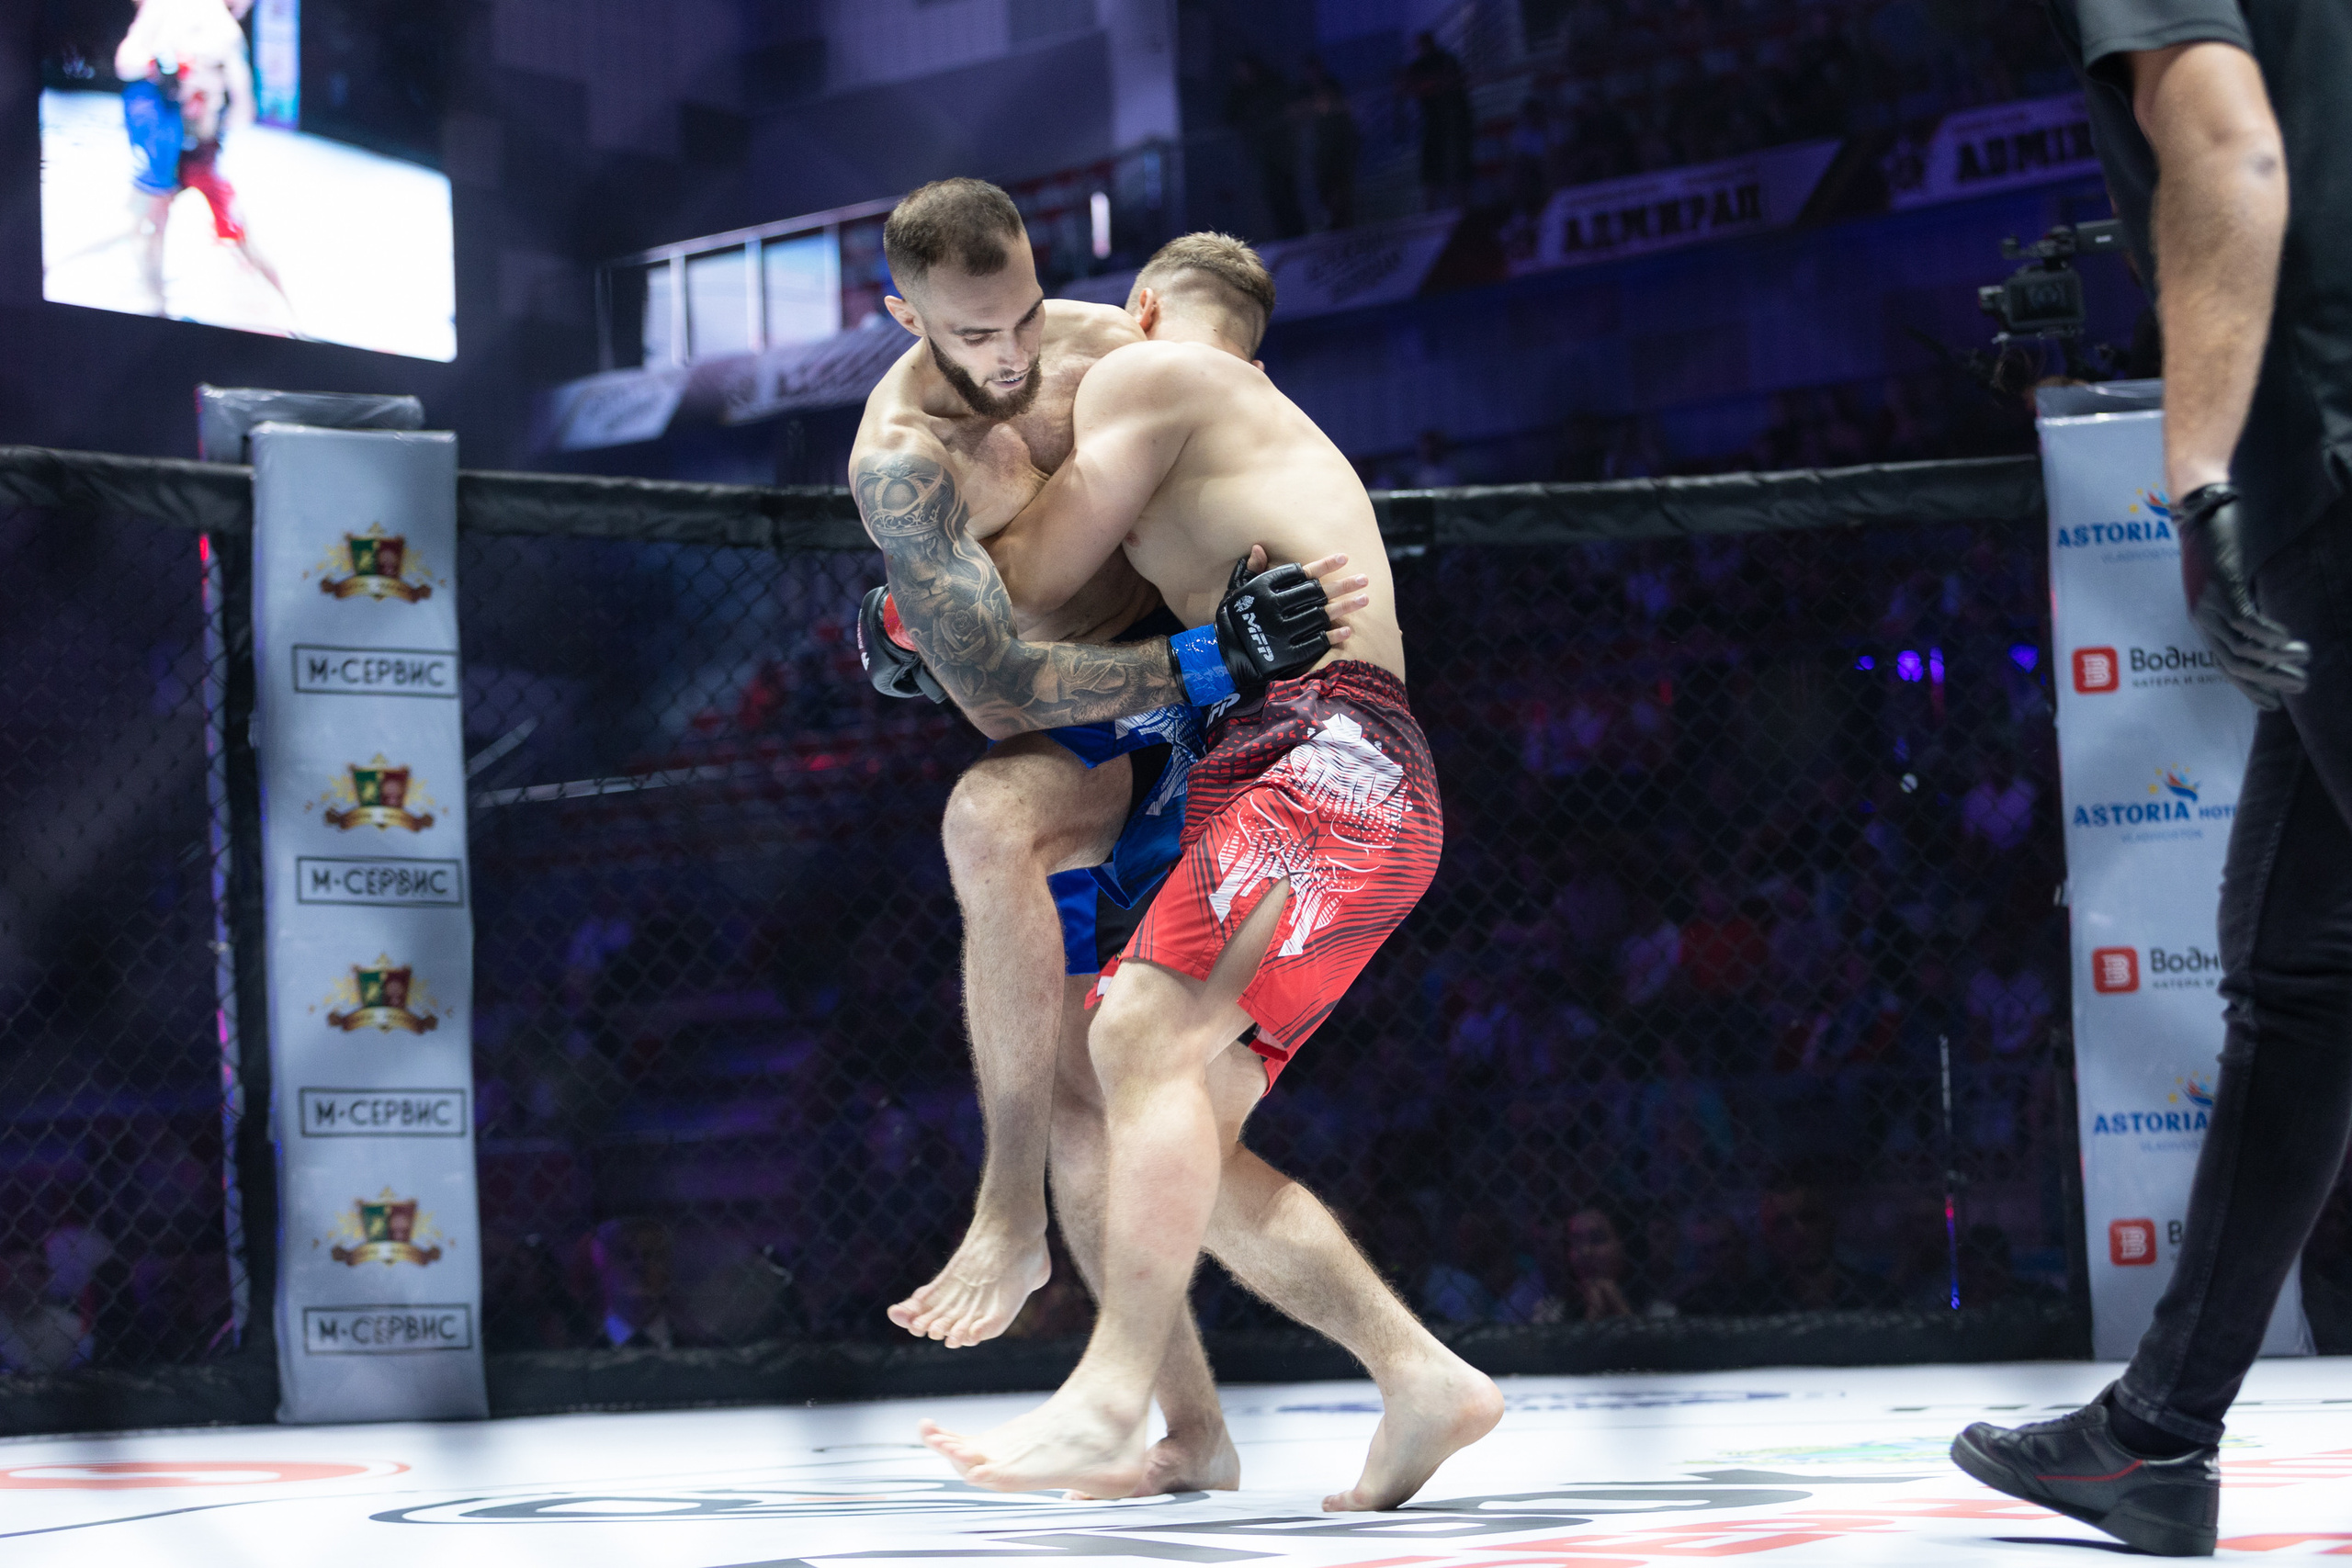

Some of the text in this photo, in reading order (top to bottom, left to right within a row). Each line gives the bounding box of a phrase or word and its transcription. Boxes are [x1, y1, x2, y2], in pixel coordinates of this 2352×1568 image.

[2057, 520, 2170, 547] ASTORIA
[1241, 612, 1275, 662] MFP
[2131, 646, 2218, 671] Водни
[2073, 800, 2237, 827] ASTORIA HOT
[2150, 945, 2219, 974] Водн
[2094, 1110, 2208, 1135] ASTORIA
